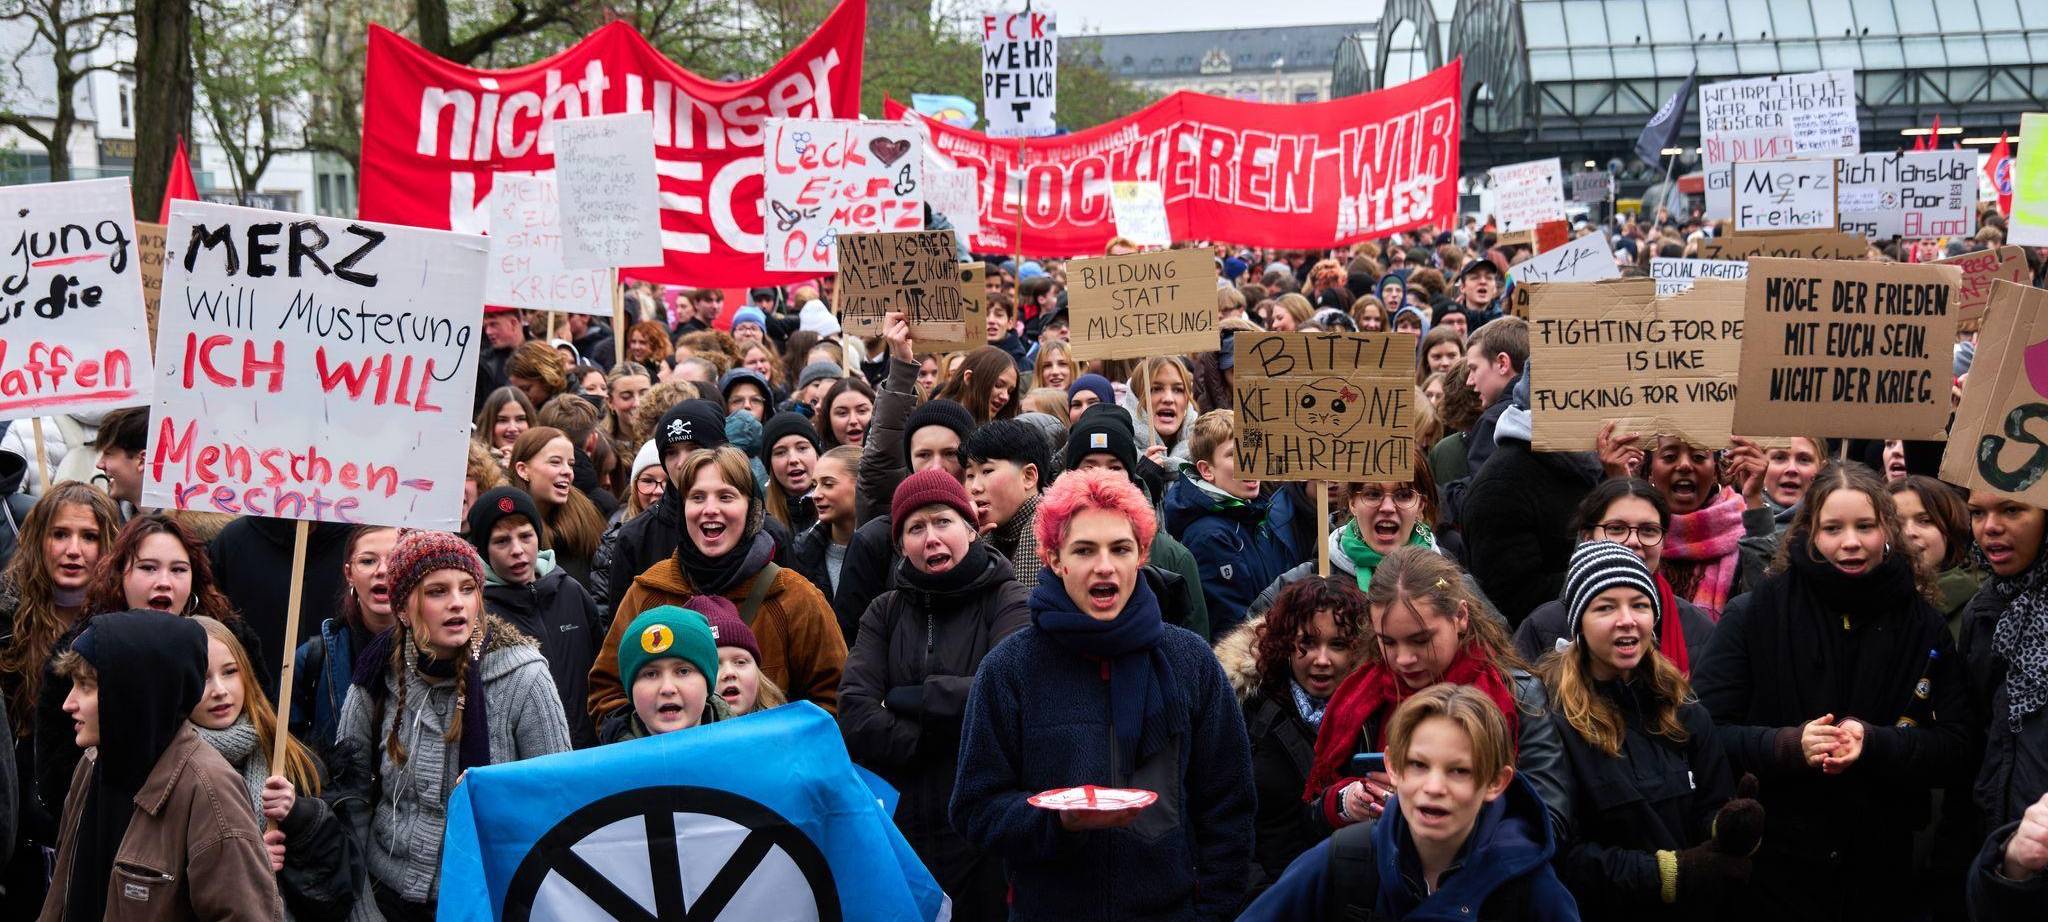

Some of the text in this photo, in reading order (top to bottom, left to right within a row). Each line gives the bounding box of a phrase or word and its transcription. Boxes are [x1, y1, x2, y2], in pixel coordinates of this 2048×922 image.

[983, 12, 1047, 40] FCK
[983, 40, 1053, 69] WEHR
[416, 48, 840, 160] nicht unser
[1011, 102, 1031, 123] T
[775, 126, 866, 174] Leck
[1339, 97, 1456, 200] WIR
[796, 176, 891, 205] Eier
[1744, 169, 1829, 194] Merz
[1901, 188, 1944, 209] Poor
[1741, 205, 1824, 228] Freiheit
[3, 208, 131, 296] jung
[184, 221, 386, 287] MERZ
[840, 236, 884, 265] MEIN
[842, 261, 899, 294] MEINE
[1080, 260, 1176, 289] BILDUNG
[1652, 261, 1695, 279] EQUAL
[34, 274, 103, 319] die
[1111, 284, 1180, 311] STATT
[1765, 277, 1822, 312] MÖGE
[1832, 279, 1868, 314] DER
[1874, 281, 1949, 316] FRIEDEN
[279, 289, 470, 381] Musterung
[1087, 309, 1213, 341] MUSTERUNG!
[1536, 319, 1667, 344] FIGHTING
[1671, 320, 1717, 342] FOR
[1784, 322, 1929, 359] MIT EUCH SEIN.
[0, 340, 131, 396] affen
[182, 332, 442, 412] ICH WILL
[1249, 333, 1390, 378] BITTI
[1626, 350, 1704, 371] IS LIKE
[1535, 386, 1634, 411] FUCKING
[1640, 385, 1679, 404] FOR
[1769, 367, 1935, 404] NICHT DER KRIEG.
[153, 417, 434, 497] Menschen-
[1234, 430, 1413, 476] WEHRPFLICHT
[174, 482, 360, 521] rechte
